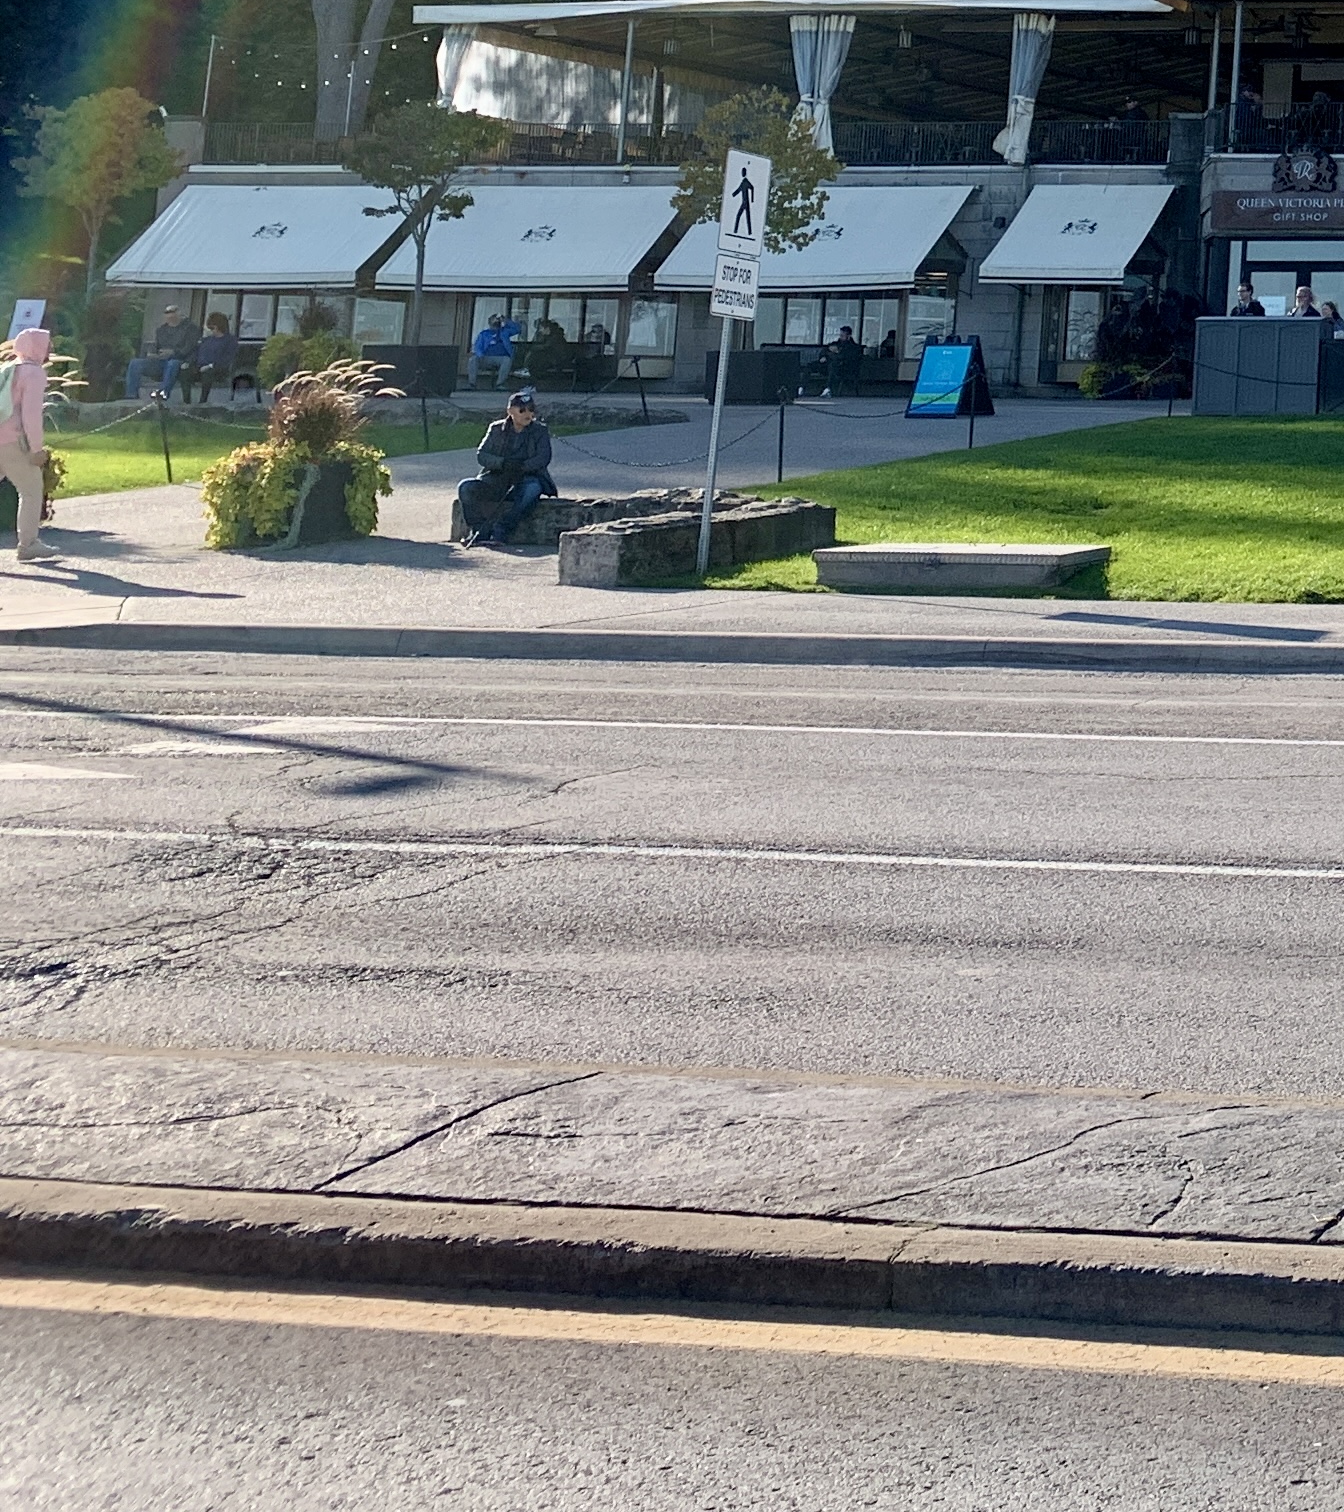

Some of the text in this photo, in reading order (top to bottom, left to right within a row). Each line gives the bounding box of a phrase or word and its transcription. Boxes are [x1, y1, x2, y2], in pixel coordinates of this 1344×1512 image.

[1236, 197, 1275, 210] QUEEN
[1279, 198, 1331, 208] VICTORIA
[1273, 212, 1329, 222] GIFT SHOP
[722, 265, 752, 285] STOP FOR
[714, 288, 754, 309] PEDESTRIANS
